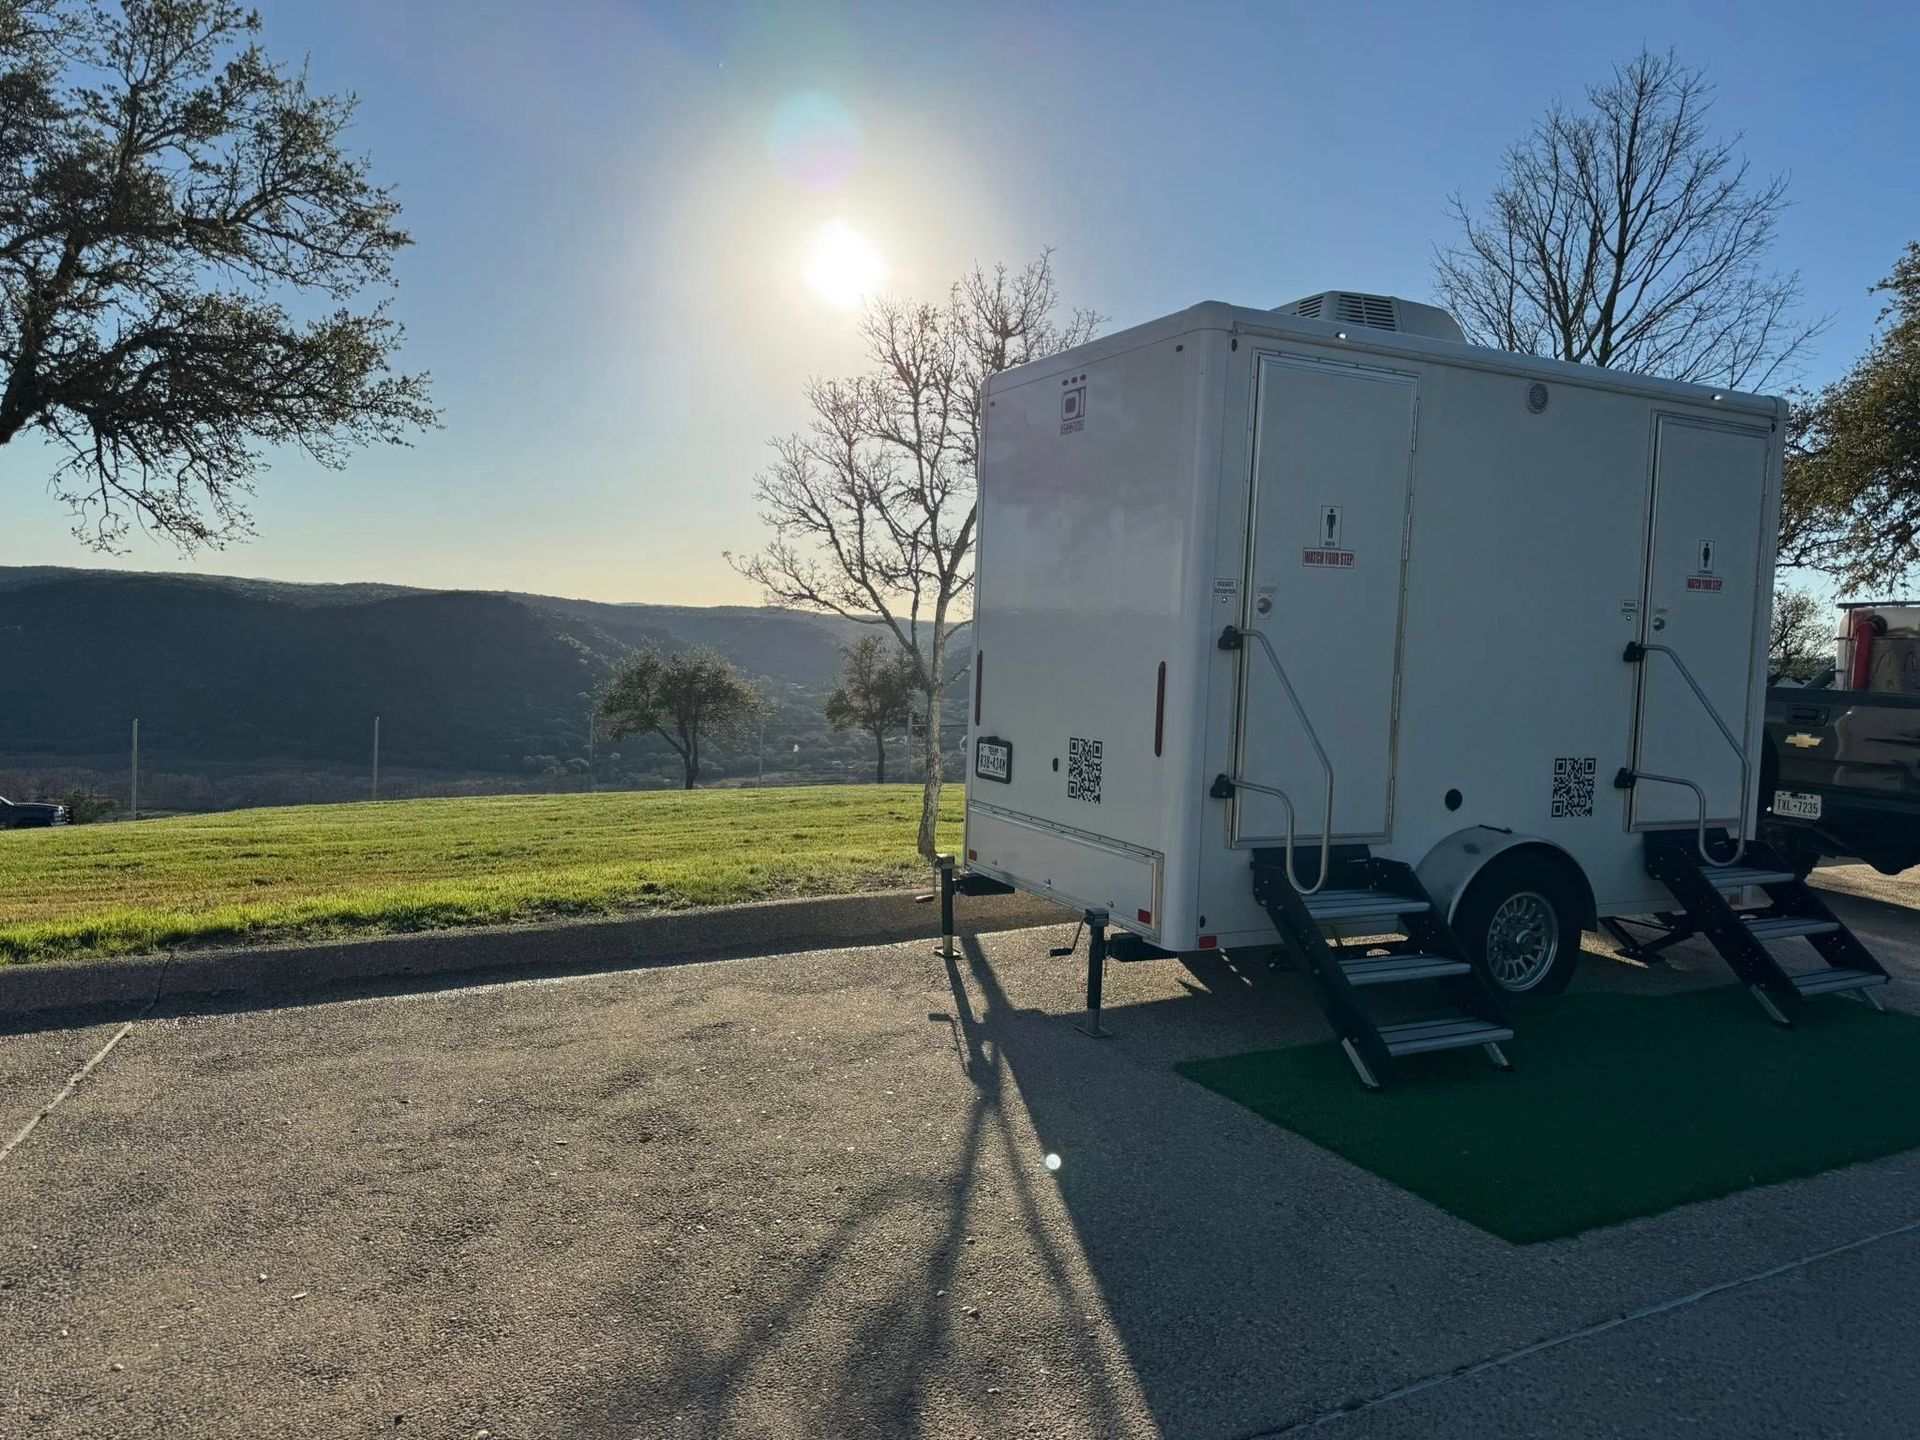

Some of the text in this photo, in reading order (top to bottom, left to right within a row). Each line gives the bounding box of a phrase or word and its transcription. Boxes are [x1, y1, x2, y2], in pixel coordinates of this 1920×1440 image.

[1304, 550, 1354, 567] WATCH YOUR STEP
